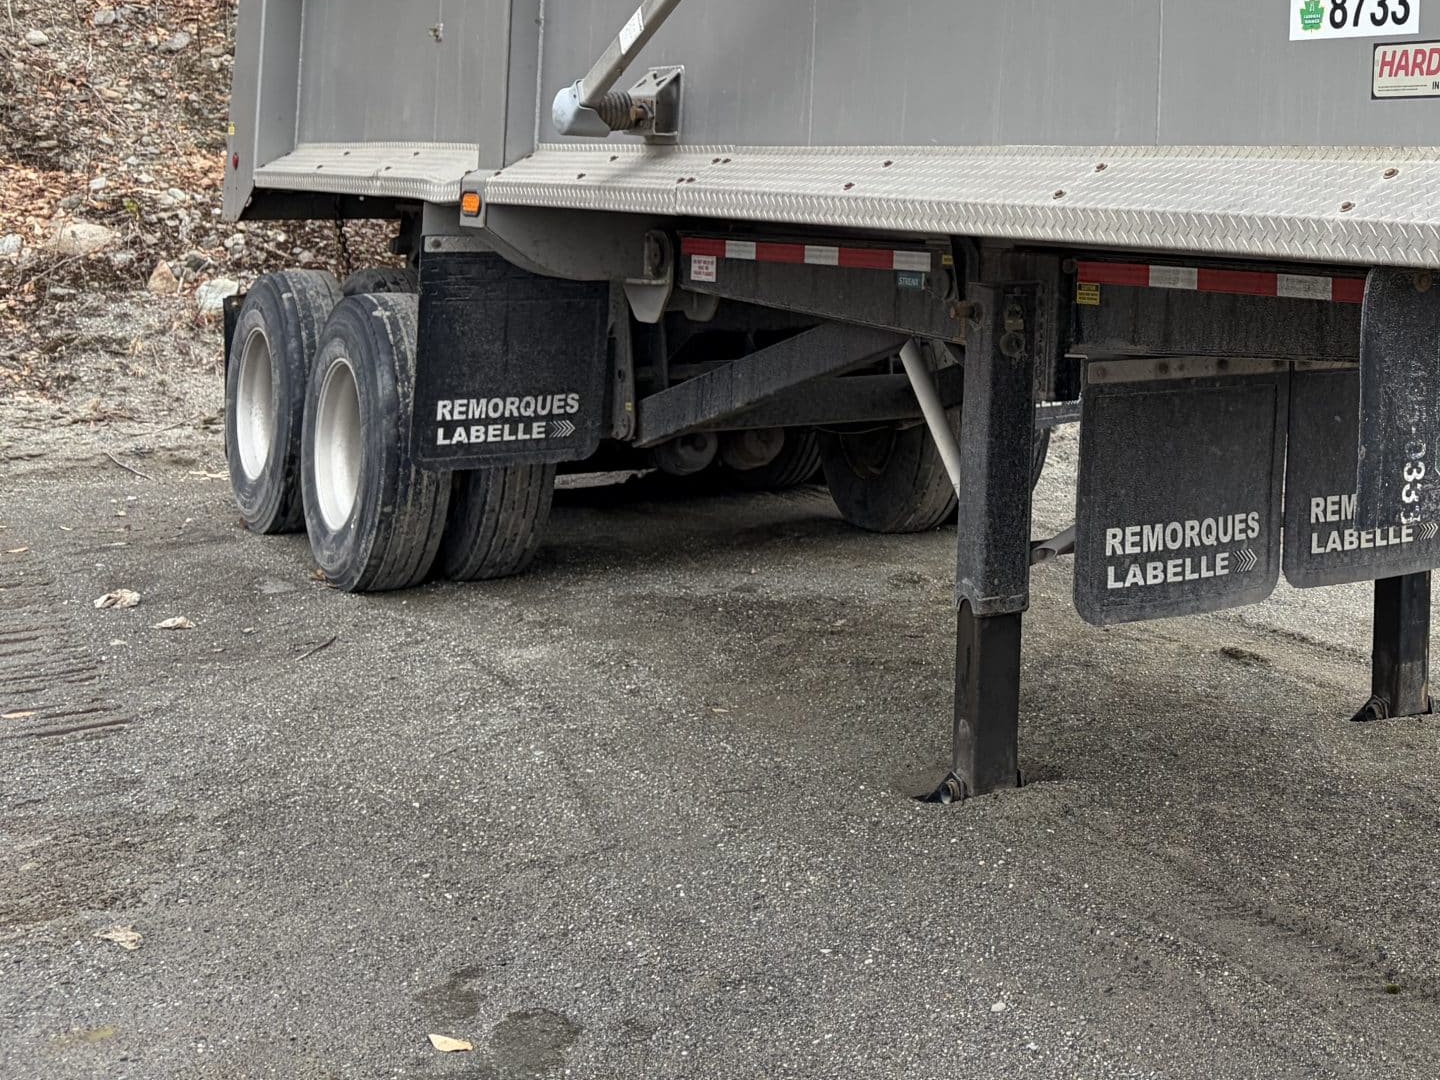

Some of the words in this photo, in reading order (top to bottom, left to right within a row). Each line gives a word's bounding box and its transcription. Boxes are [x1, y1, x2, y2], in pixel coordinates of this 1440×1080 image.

[1432, 81, 1440, 90] IN
[436, 392, 580, 421] REMORQUES
[436, 421, 547, 446] LABELLE
[1105, 511, 1260, 557] REMORQUES
[1311, 524, 1414, 554] LABELLE
[1107, 552, 1230, 589] LABELLE
